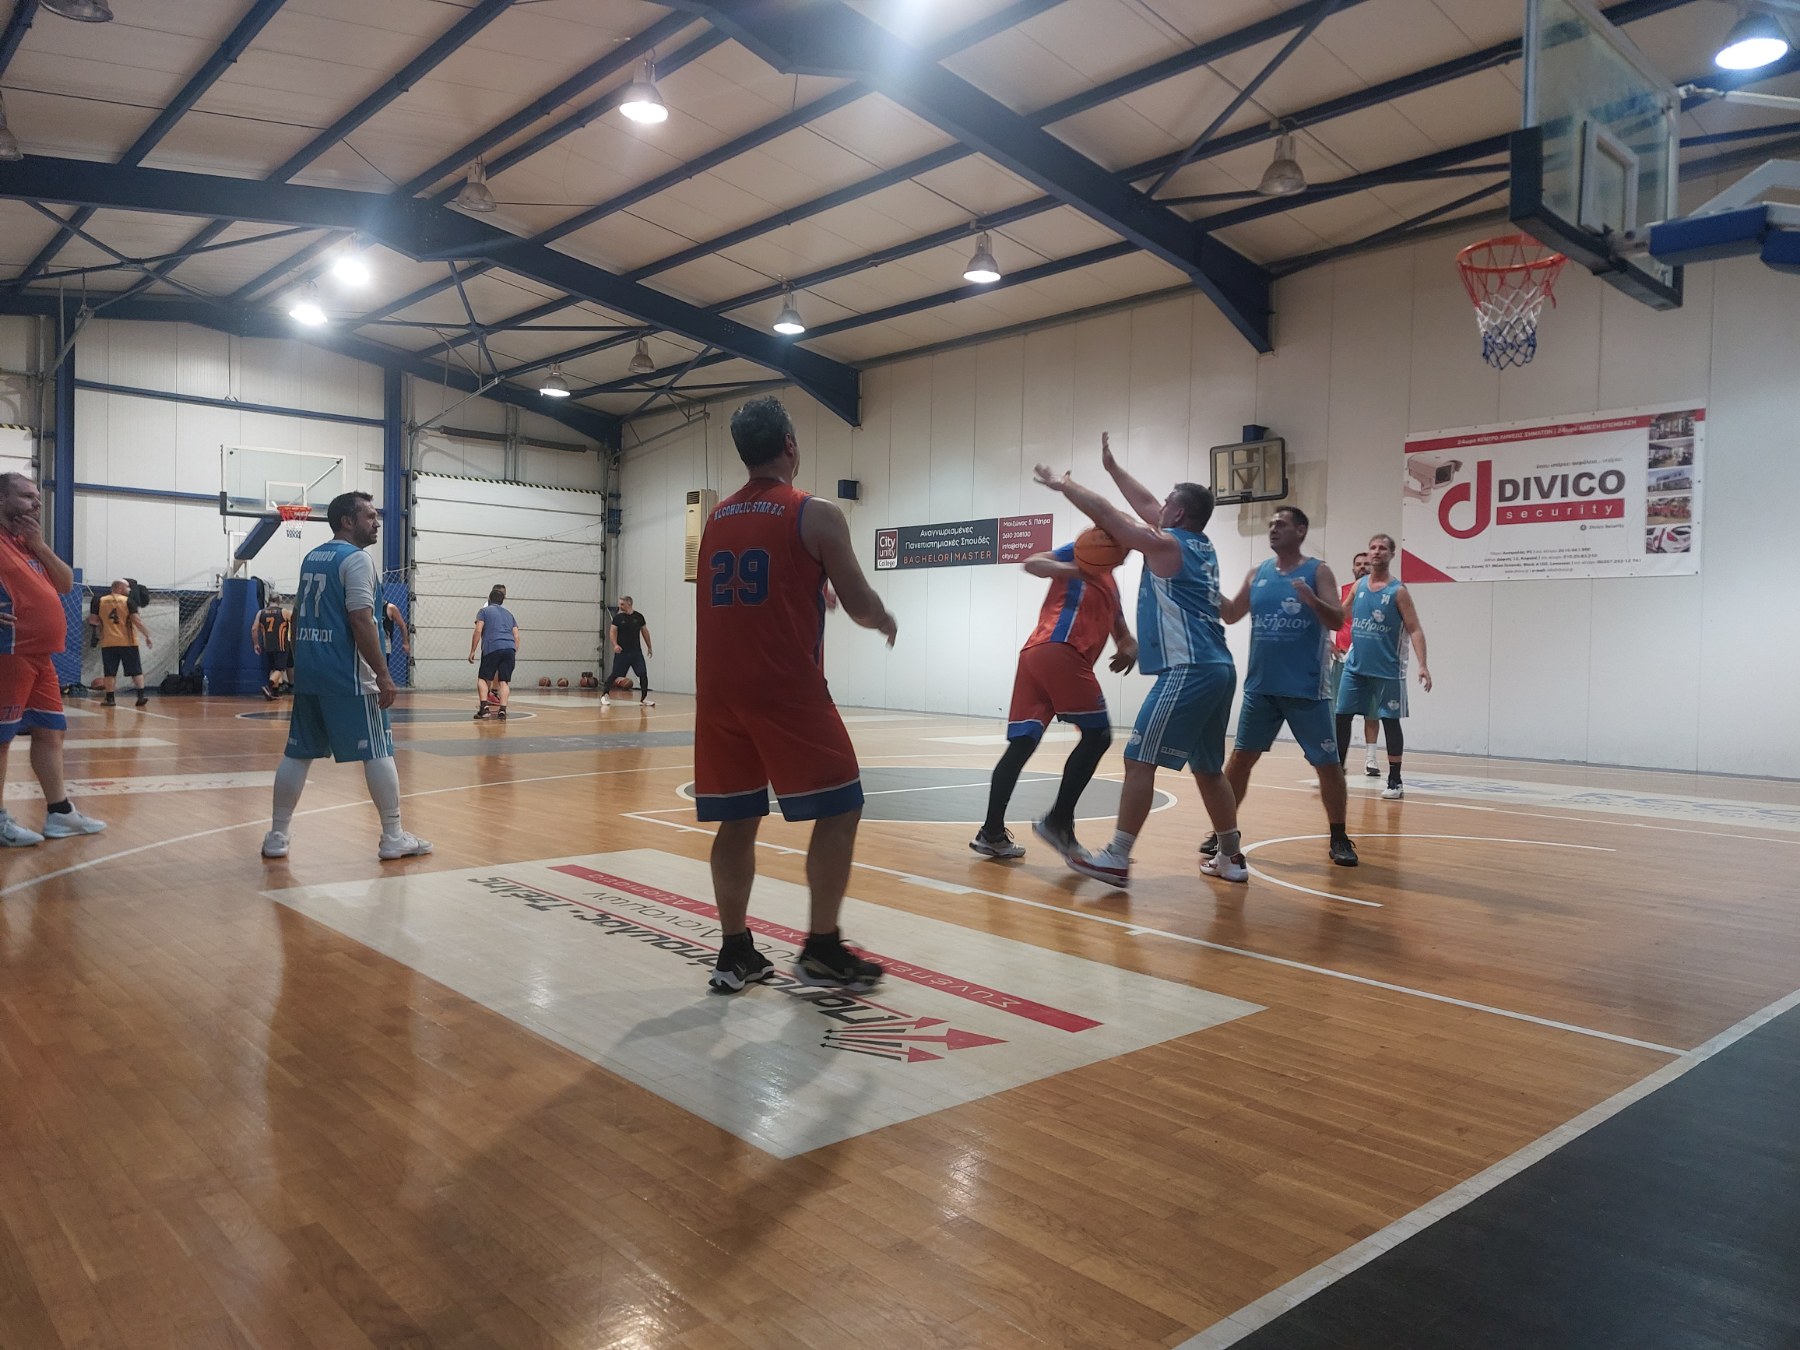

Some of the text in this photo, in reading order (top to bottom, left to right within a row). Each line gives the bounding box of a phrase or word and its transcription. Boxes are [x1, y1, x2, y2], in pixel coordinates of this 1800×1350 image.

[1498, 469, 1626, 502] DIVICO
[1506, 504, 1613, 519] security
[920, 526, 974, 538] Αναγνωρισμένες
[879, 536, 896, 549] City
[905, 535, 991, 550] Πανεπιστημιακές Σπουδές
[879, 548, 896, 558] unity
[903, 550, 992, 564] BACHELOR MASTER
[878, 560, 896, 568] College
[710, 548, 771, 607] 29
[300, 572, 327, 618] 77
[108, 608, 120, 625] 4
[265, 617, 275, 632] 7
